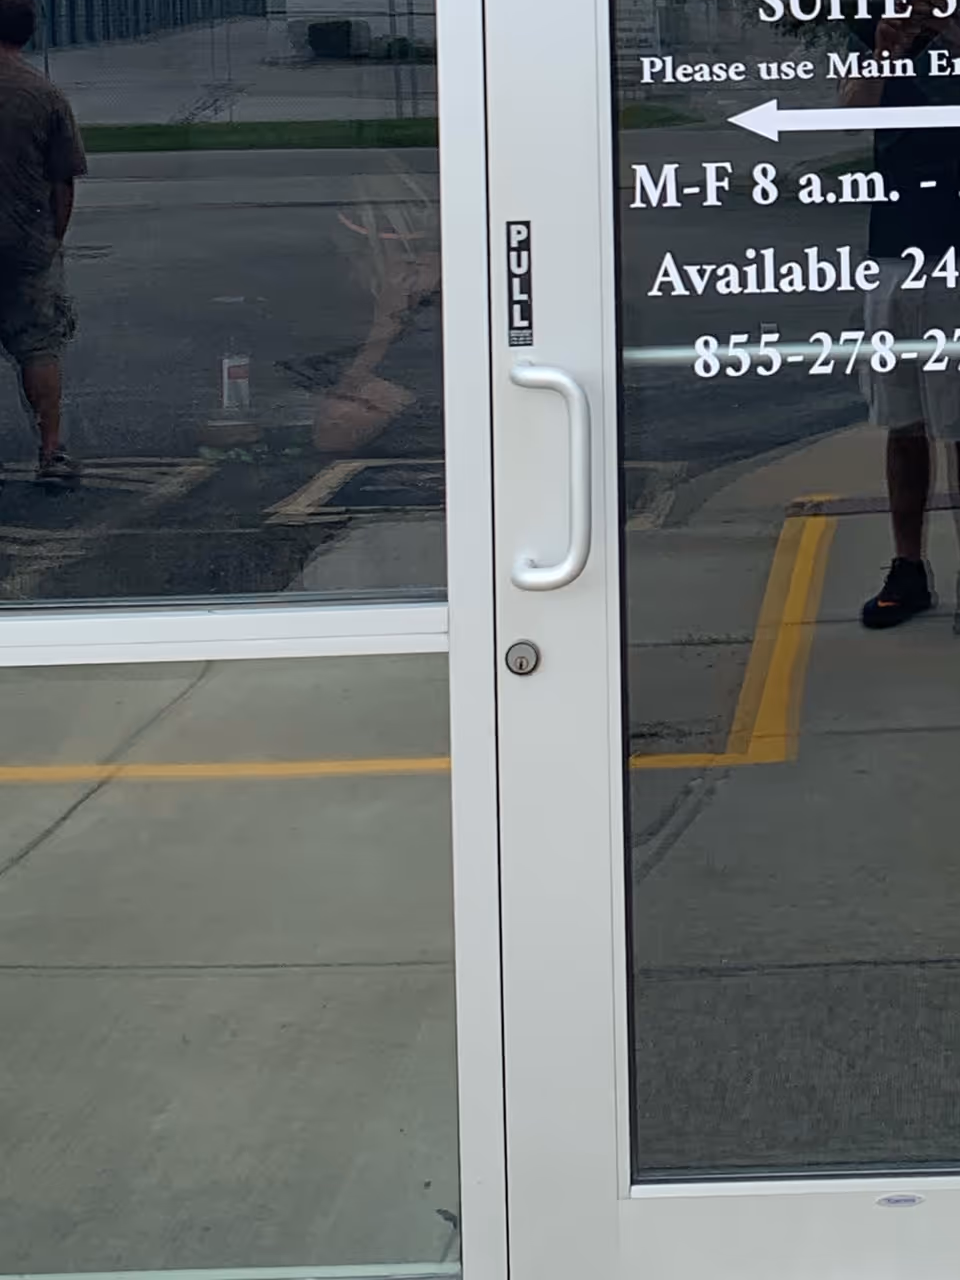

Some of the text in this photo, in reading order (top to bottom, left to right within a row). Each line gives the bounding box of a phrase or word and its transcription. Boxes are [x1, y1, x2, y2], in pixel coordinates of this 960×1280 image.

[640, 56, 746, 84] Please
[758, 61, 815, 81] use
[826, 50, 917, 79] Main
[629, 161, 733, 208] M-F
[752, 163, 777, 205] 8
[798, 172, 901, 204] a.m.
[509, 224, 530, 328] PULL
[647, 246, 881, 297] Available
